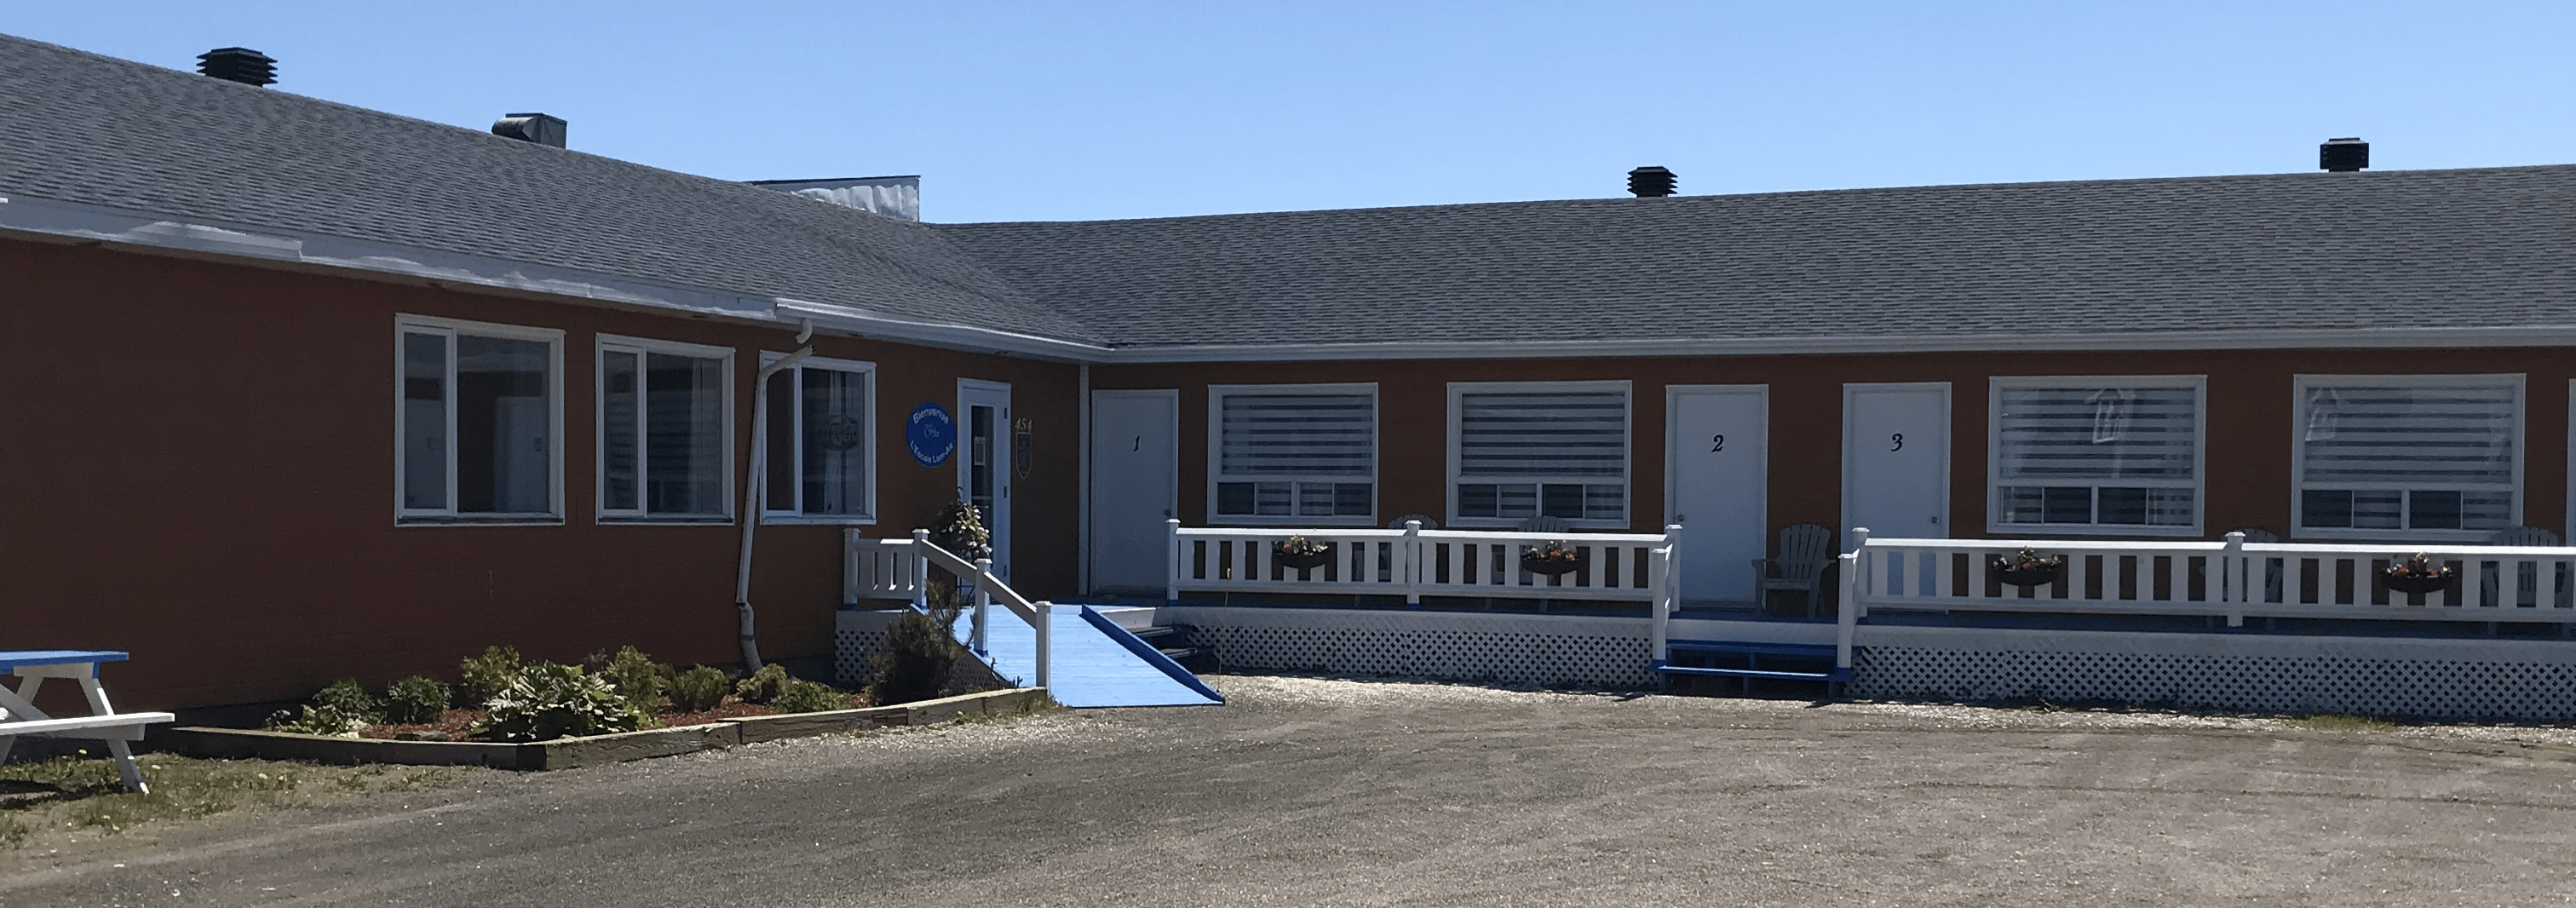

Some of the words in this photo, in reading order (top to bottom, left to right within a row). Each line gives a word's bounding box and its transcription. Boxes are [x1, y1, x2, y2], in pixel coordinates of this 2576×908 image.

[912, 408, 949, 424] Bienvenue
[1015, 417, 1033, 432] 454
[1133, 435, 1141, 453] 1
[1711, 434, 1725, 453] 2
[1890, 433, 1904, 452] 3
